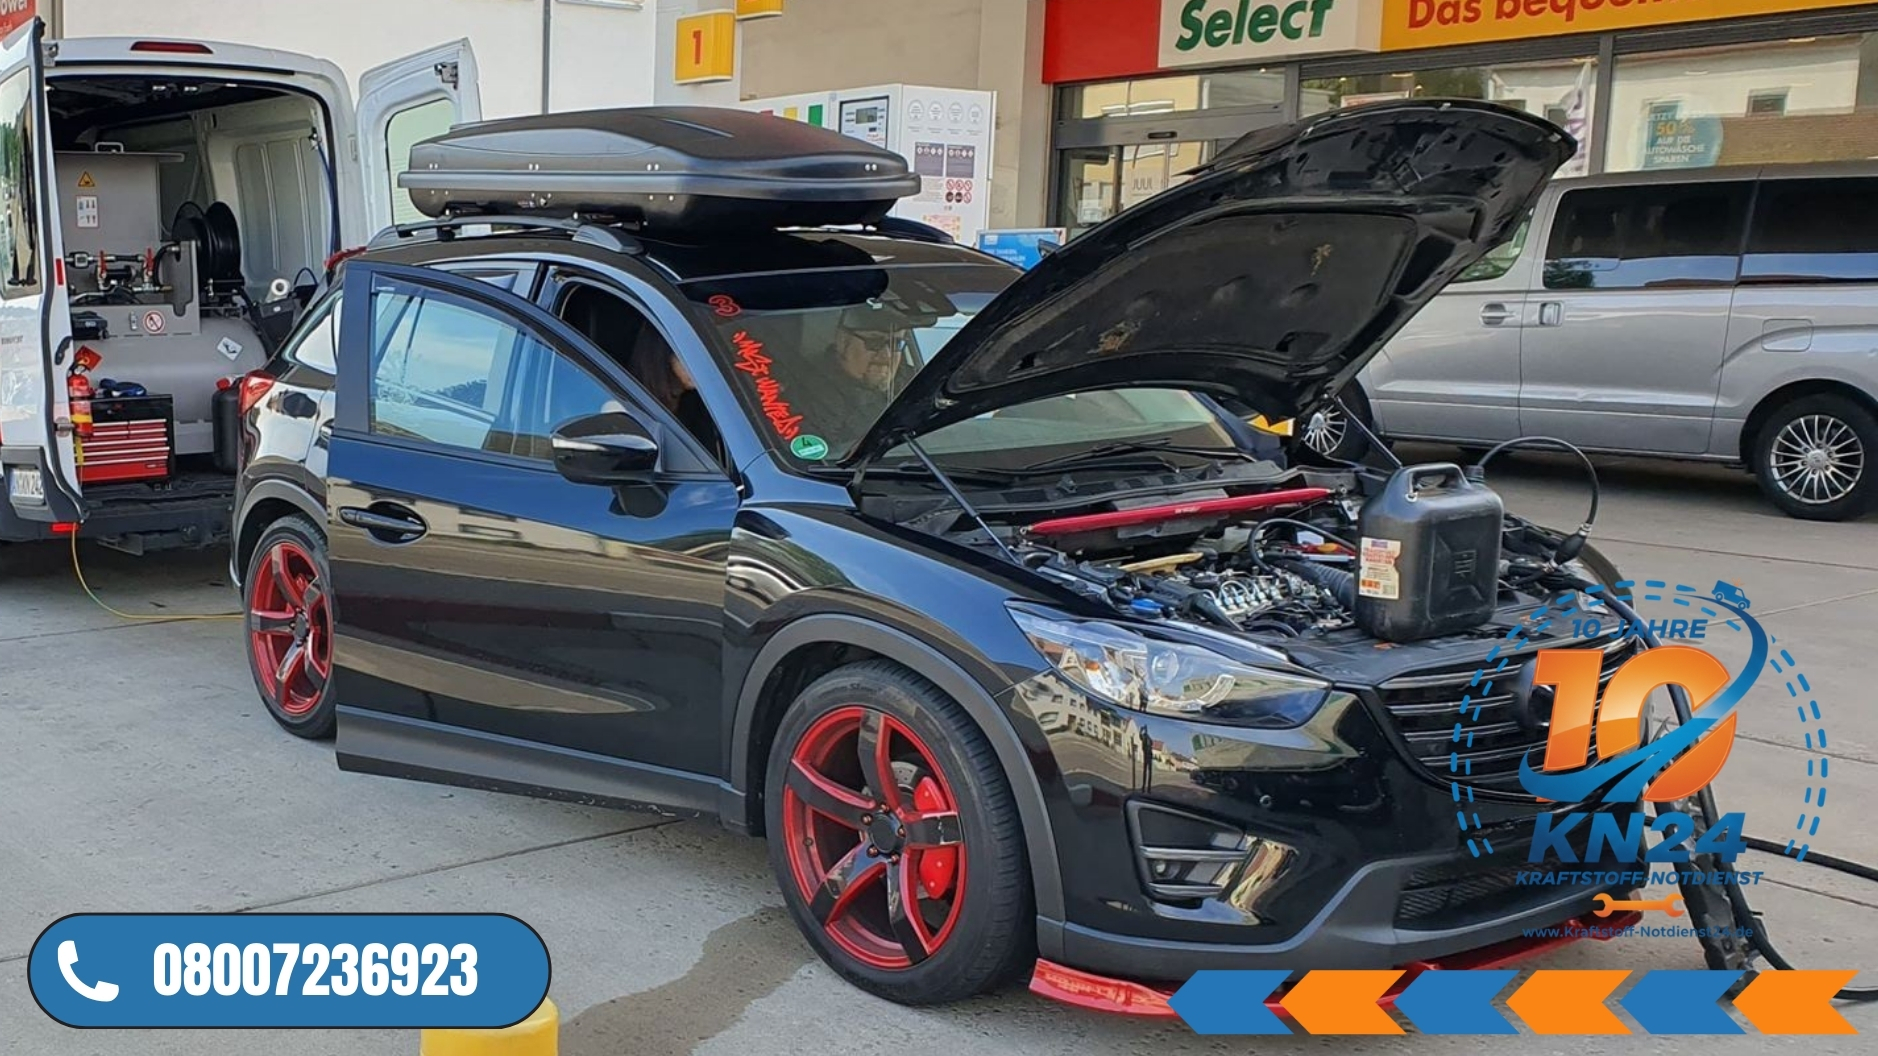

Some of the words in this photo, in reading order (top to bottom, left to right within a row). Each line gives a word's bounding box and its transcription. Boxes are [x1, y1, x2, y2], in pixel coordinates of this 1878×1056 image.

[1175, 0, 1335, 51] Select
[1408, 0, 1482, 29] Das
[693, 30, 702, 65] 1
